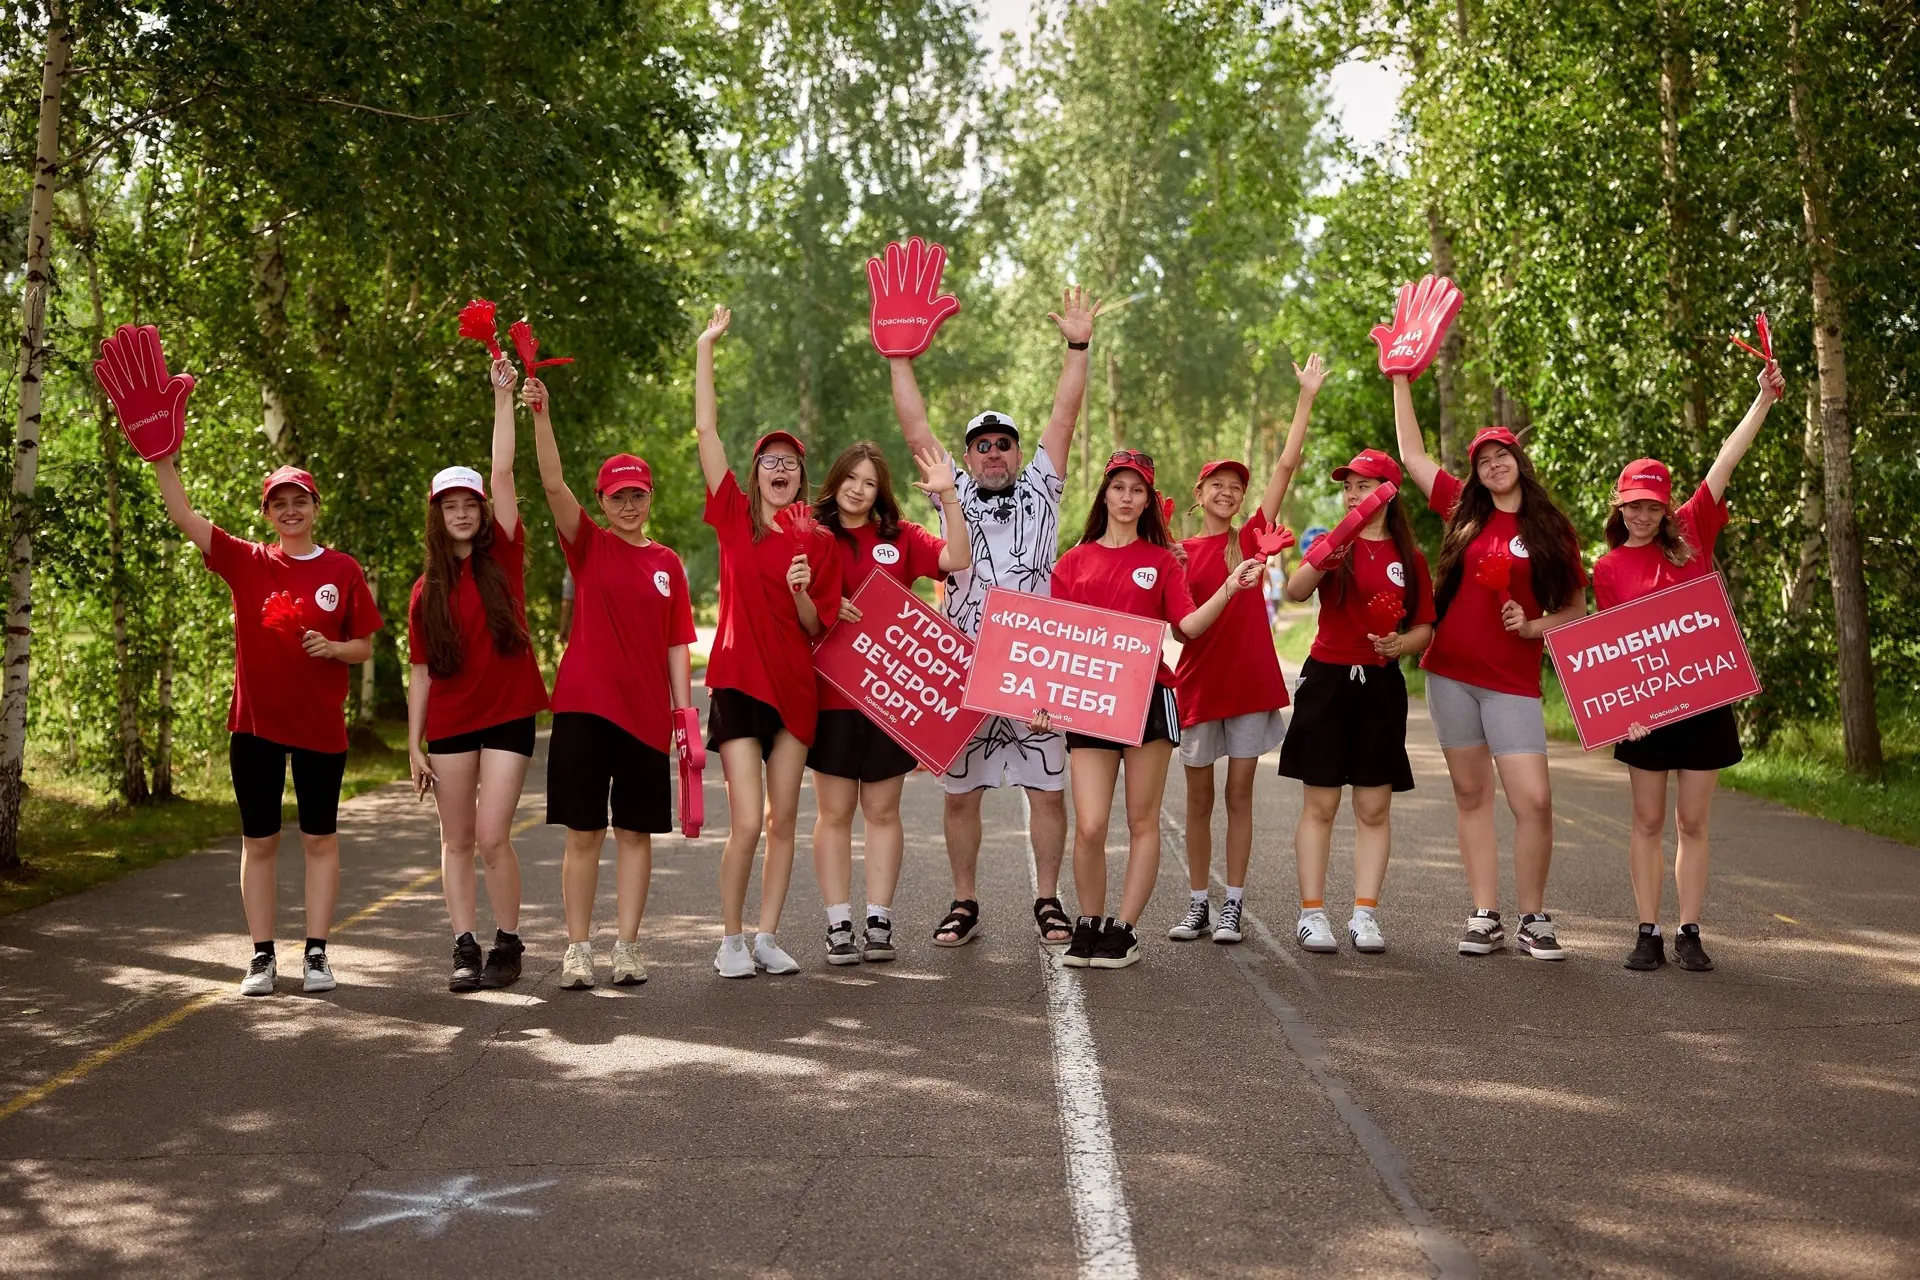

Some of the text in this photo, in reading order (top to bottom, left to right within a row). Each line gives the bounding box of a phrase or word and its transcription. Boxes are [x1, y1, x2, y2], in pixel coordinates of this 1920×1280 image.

[877, 316, 928, 327] Красный Яр
[1387, 342, 1424, 359] ПЯТЬ!
[1392, 329, 1423, 346] ДАЙ
[127, 410, 169, 432] Красный Яр
[877, 548, 895, 559] Яр
[1137, 571, 1155, 583] Яр
[320, 589, 336, 605] Яр
[897, 600, 972, 670] УТРОМ
[991, 610, 1151, 655] «КРАСНЫЙ ЯР»
[1567, 611, 1720, 673] УЛЫБНИСЬ,
[885, 625, 961, 687] СПОРТ
[1009, 640, 1123, 683] БОЛЕЕТ
[1631, 648, 1670, 675] ТЫ
[852, 632, 959, 722] ВЕЧЕРОМ
[1583, 651, 1738, 719] ПРЕКРАСНА!
[860, 668, 924, 727] ТОРТ!
[999, 672, 1116, 716] ЗА ТЕБЯ
[864, 694, 898, 723] Красный Яр
[1063, 715, 1073, 723] Яр
[1649, 702, 1690, 720] Красный Яр
